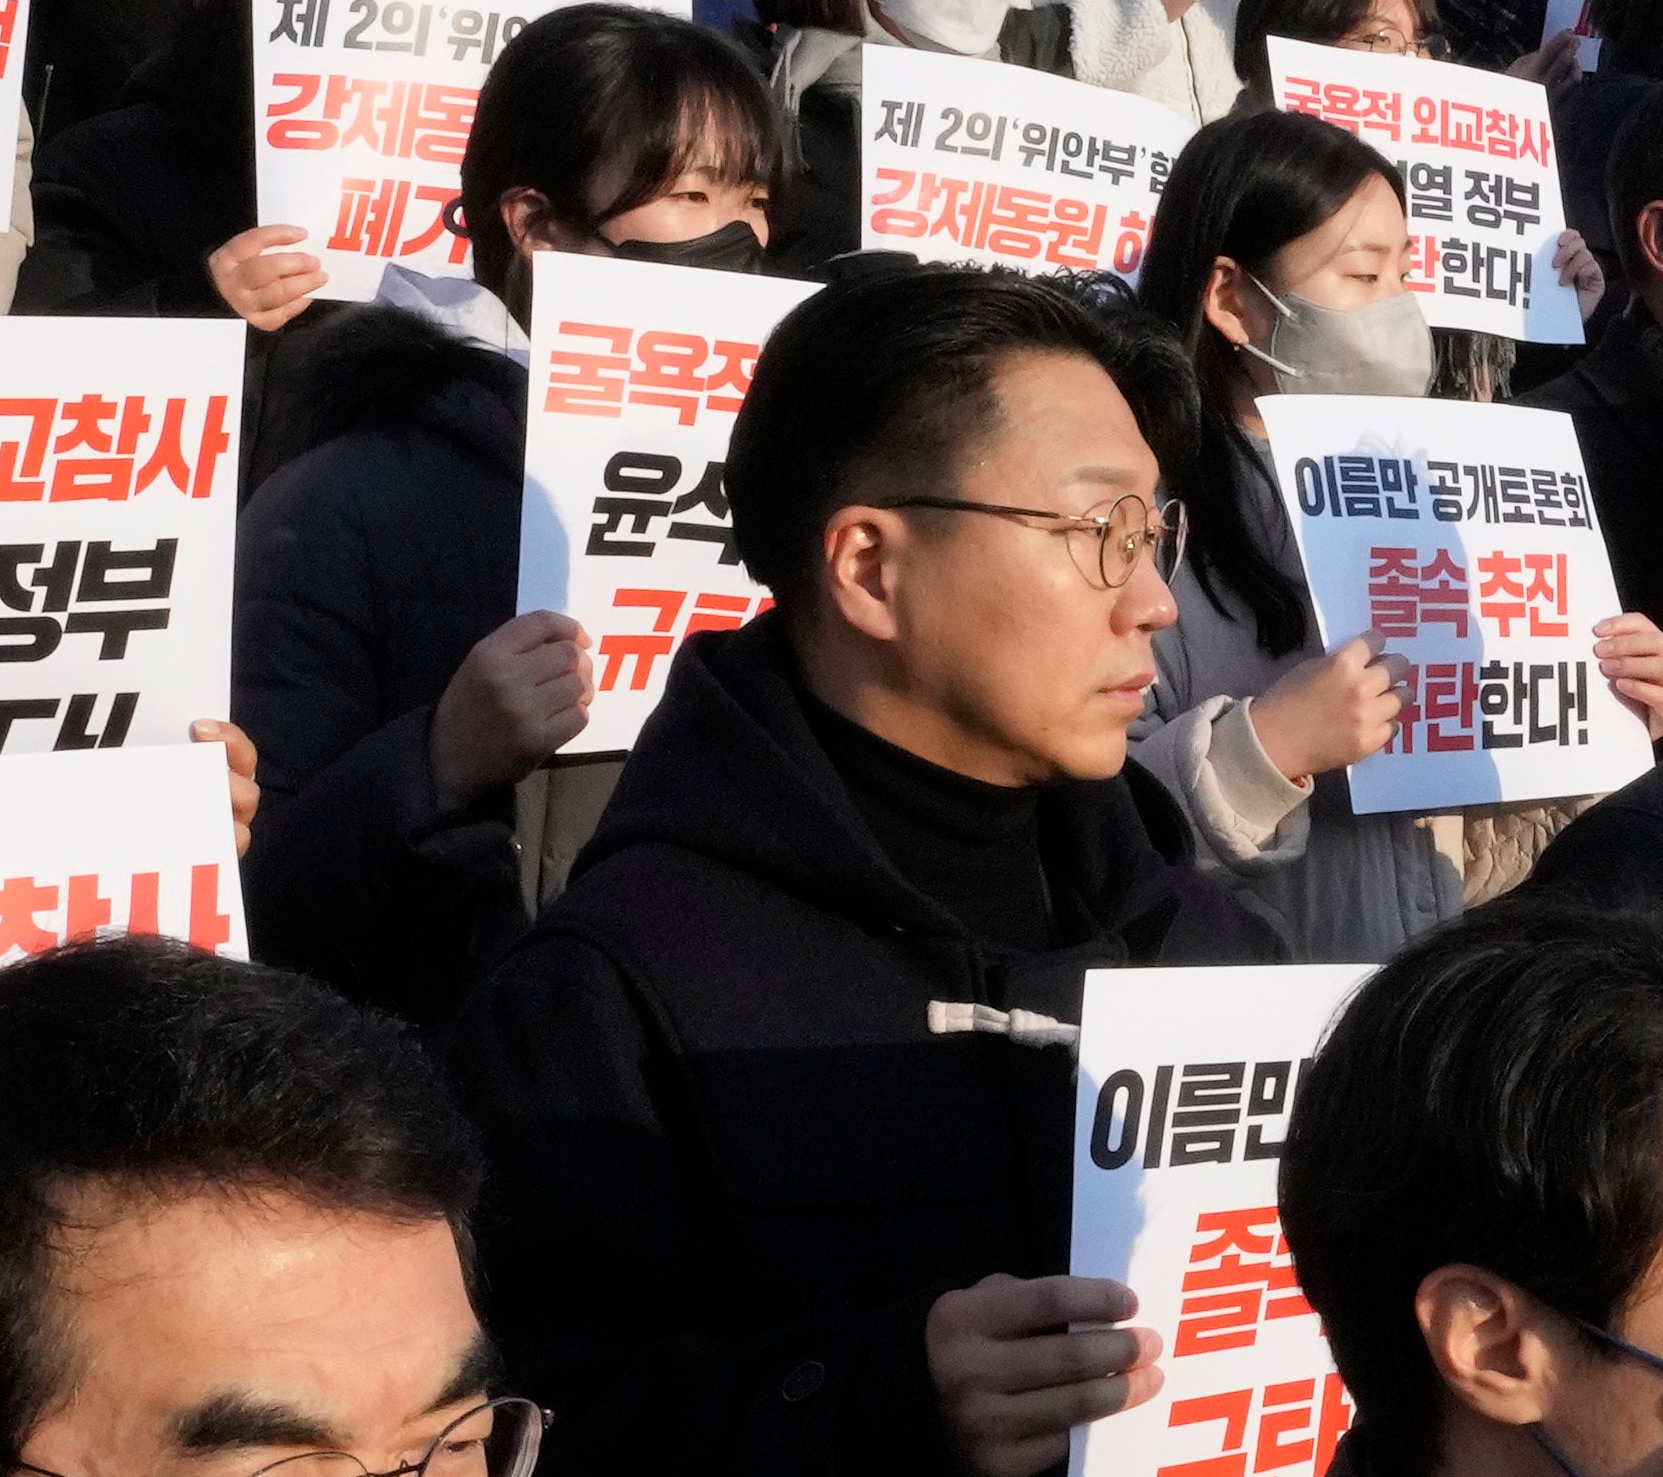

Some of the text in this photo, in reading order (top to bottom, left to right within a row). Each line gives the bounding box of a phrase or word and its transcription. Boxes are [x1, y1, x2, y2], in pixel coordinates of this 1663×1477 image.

[874, 99, 926, 150] 제
[1411, 96, 1550, 167] 외교참사
[871, 166, 1109, 271] 강제동원
[1464, 169, 1541, 235] 정부
[1295, 456, 1593, 531] 이름만 공개토론회
[1368, 547, 1569, 639] 졸속 추진
